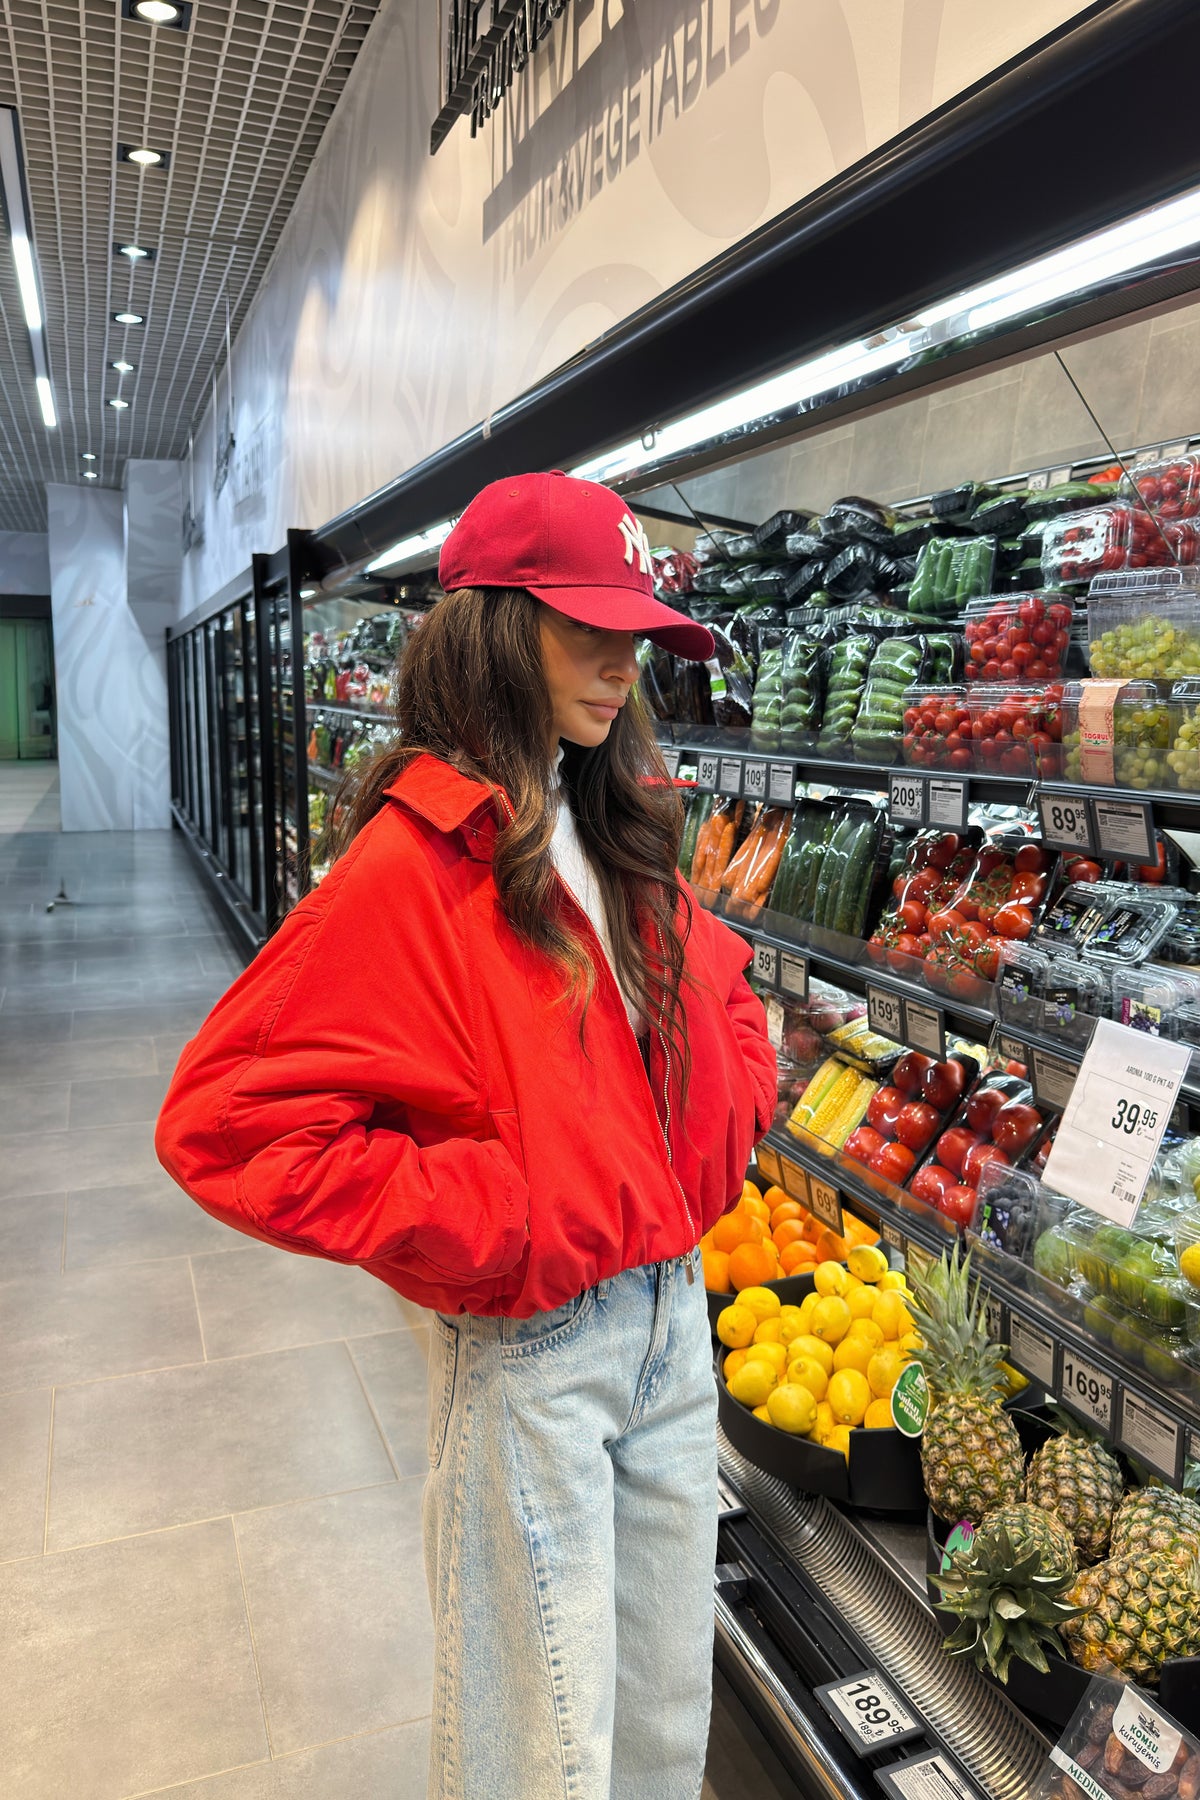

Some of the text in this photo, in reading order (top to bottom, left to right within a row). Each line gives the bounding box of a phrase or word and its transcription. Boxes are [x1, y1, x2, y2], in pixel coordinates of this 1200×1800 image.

[617, 513, 654, 577] NY
[702, 762, 713, 779] 99
[746, 769, 761, 786] 109
[892, 786, 923, 807] 209 95
[1051, 806, 1086, 832] 89 95
[758, 951, 771, 971] 59
[870, 996, 893, 1021] 159
[1126, 1065, 1144, 1078] ARONIA
[1144, 1072, 1153, 1082] 100
[1156, 1077, 1168, 1087] PKT
[816, 1187, 831, 1212] 69
[1065, 1363, 1112, 1404] 169 95
[846, 1683, 891, 1725] 189
[887, 1719, 905, 1734] 95
[891, 1699, 909, 1721] ANANAS
[857, 1720, 873, 1735] 189
